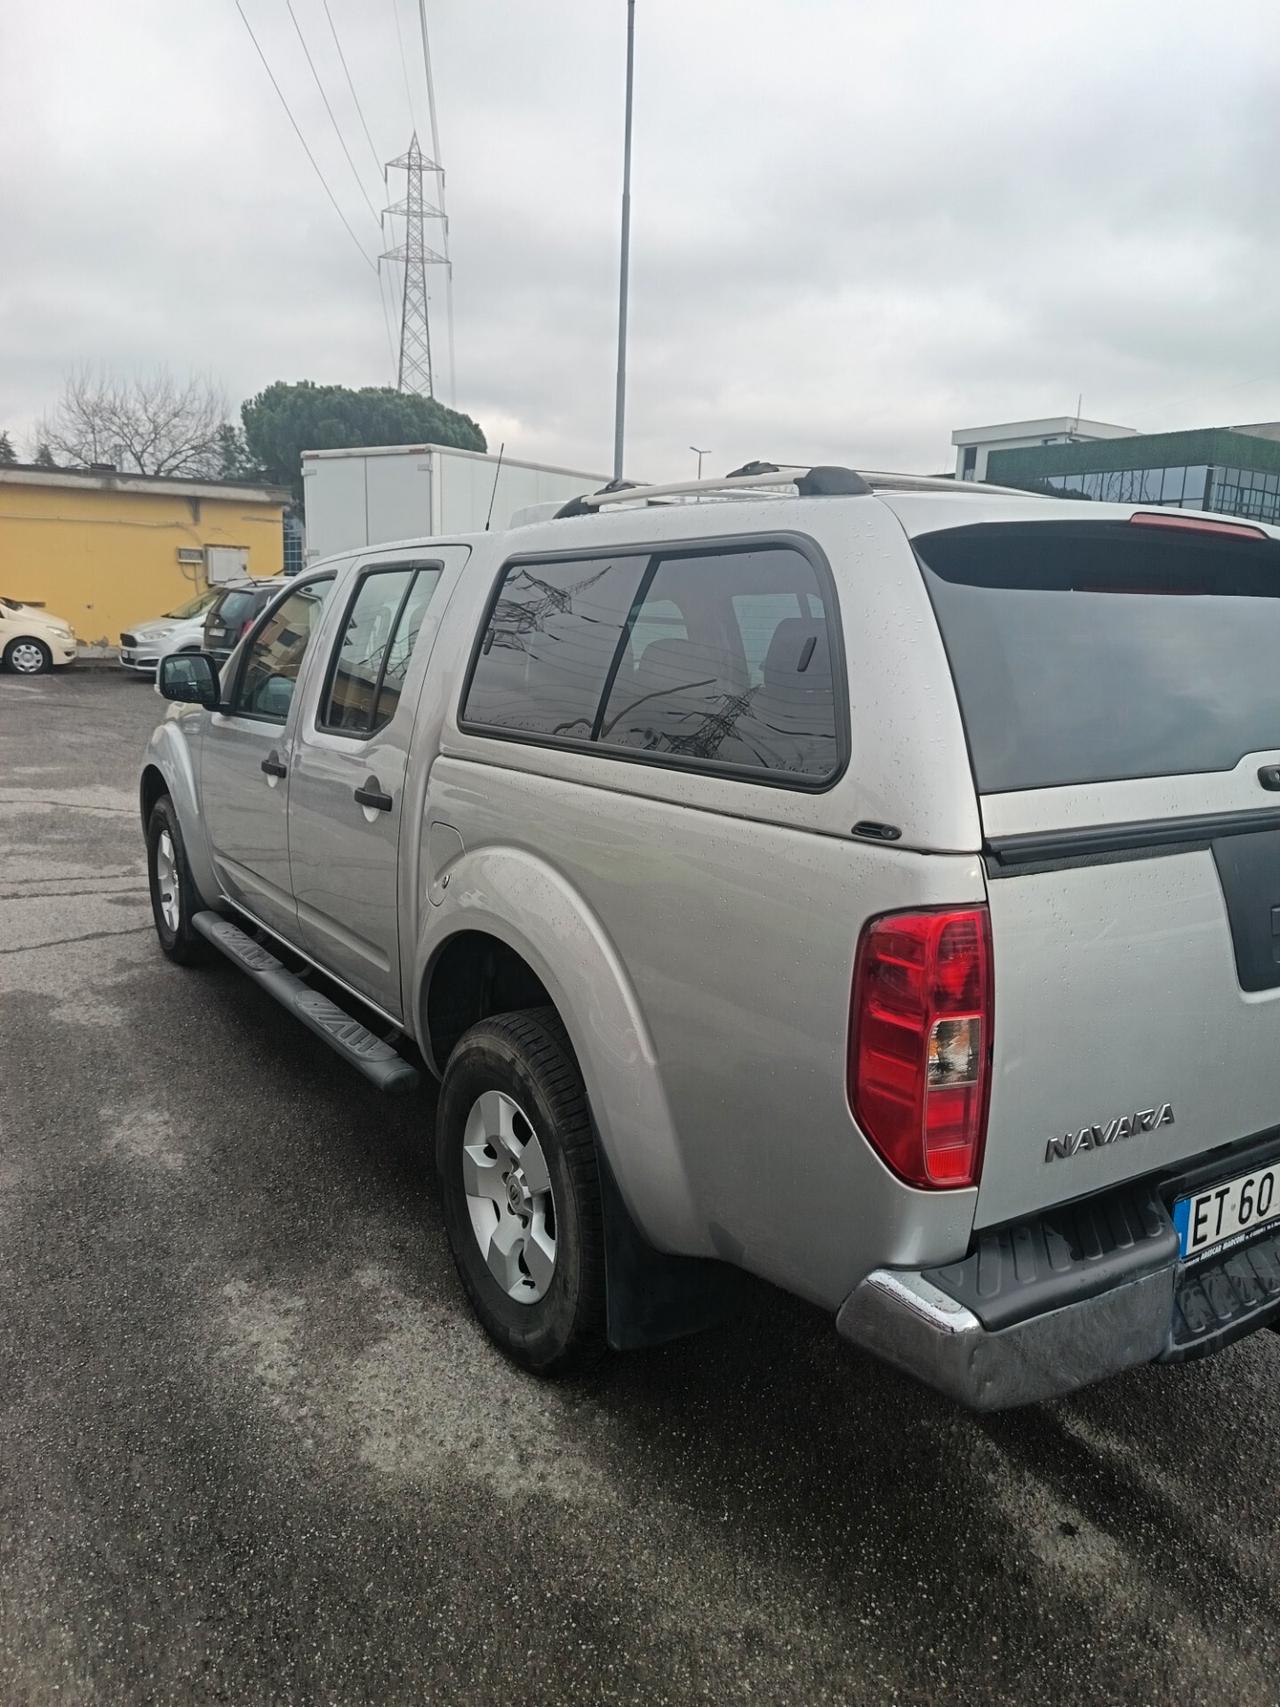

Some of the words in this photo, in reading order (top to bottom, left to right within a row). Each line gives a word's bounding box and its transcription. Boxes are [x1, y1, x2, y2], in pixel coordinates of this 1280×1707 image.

[1045, 1103, 1175, 1163] NAVARA
[1192, 1187, 1231, 1246] ET
[1238, 1172, 1275, 1225] 60
